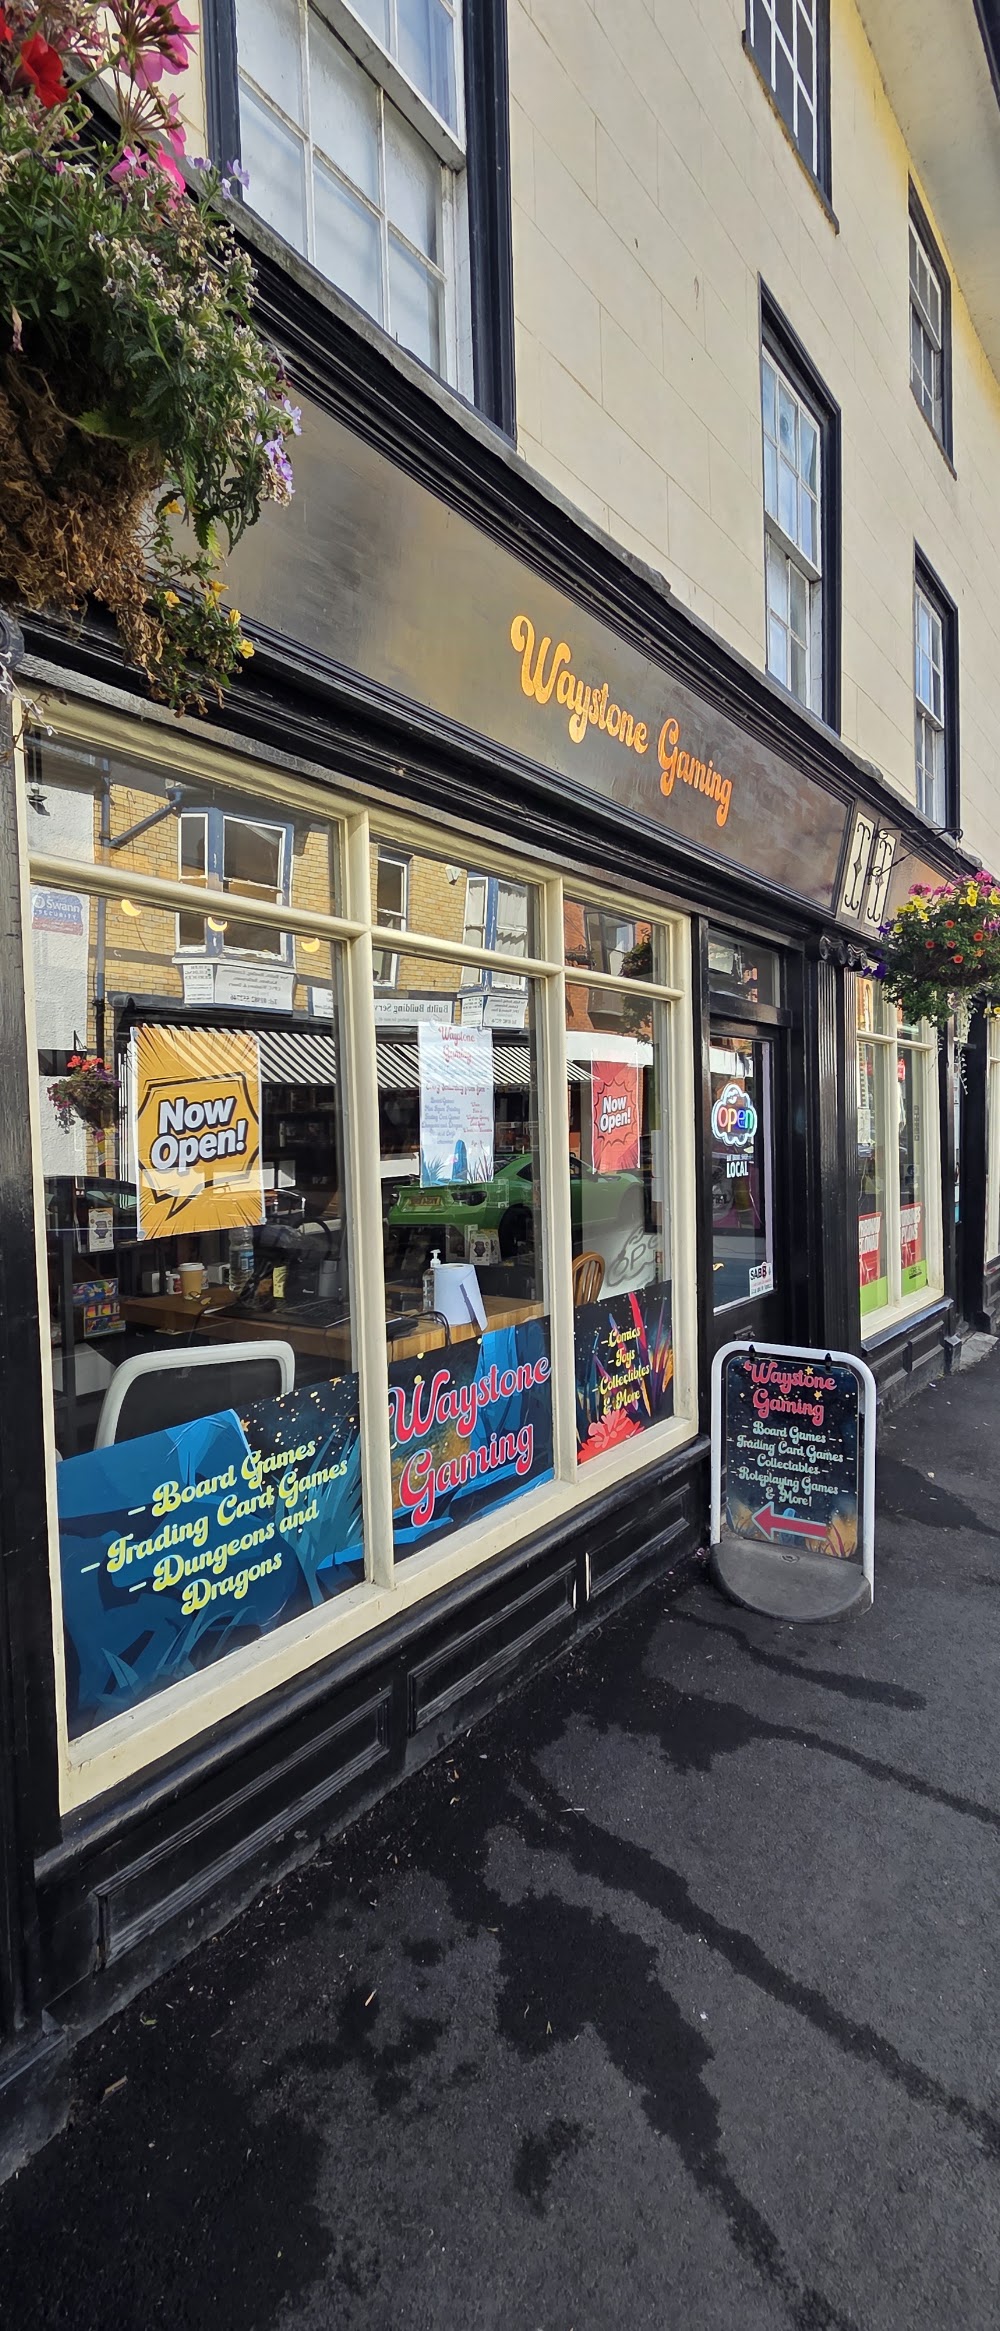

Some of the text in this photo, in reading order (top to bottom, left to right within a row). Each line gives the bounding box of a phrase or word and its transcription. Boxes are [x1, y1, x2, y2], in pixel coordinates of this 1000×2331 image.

[511, 616, 733, 827] Waystone Gaming
[46, 898, 80, 912] Swann
[158, 1096, 238, 1135] Now
[603, 1095, 627, 1114] Now
[718, 1106, 753, 1132] open
[600, 1107, 631, 1134] Open!
[150, 1118, 249, 1176] Open!
[726, 1160, 749, 1178] LOCAL
[608, 1326, 641, 1348] Comics
[615, 1348, 636, 1369] Toys
[599, 1364, 650, 1395] Collectibles
[743, 1360, 837, 1394] Waystone
[388, 1356, 552, 1444] Waystone
[603, 1388, 641, 1415] & More
[752, 1388, 824, 1426] Gaming
[753, 1421, 787, 1437] Board
[789, 1426, 826, 1444] Games
[736, 1434, 776, 1456] Trading
[778, 1441, 804, 1455] Card
[806, 1445, 844, 1463] Games
[152, 1465, 237, 1517] Board
[241, 1440, 316, 1490] Games
[399, 1423, 534, 1527] Gaming
[757, 1454, 820, 1475] Collectables
[738, 1467, 800, 1493] Roleplaying
[801, 1477, 839, 1495] Games
[765, 1487, 812, 1507] & More!
[106, 1514, 209, 1573] Trading
[217, 1487, 275, 1526] Card
[278, 1459, 348, 1508] Games
[152, 1518, 275, 1592] Dungeons
[280, 1499, 319, 1533] and
[181, 1552, 282, 1616] Dragons
